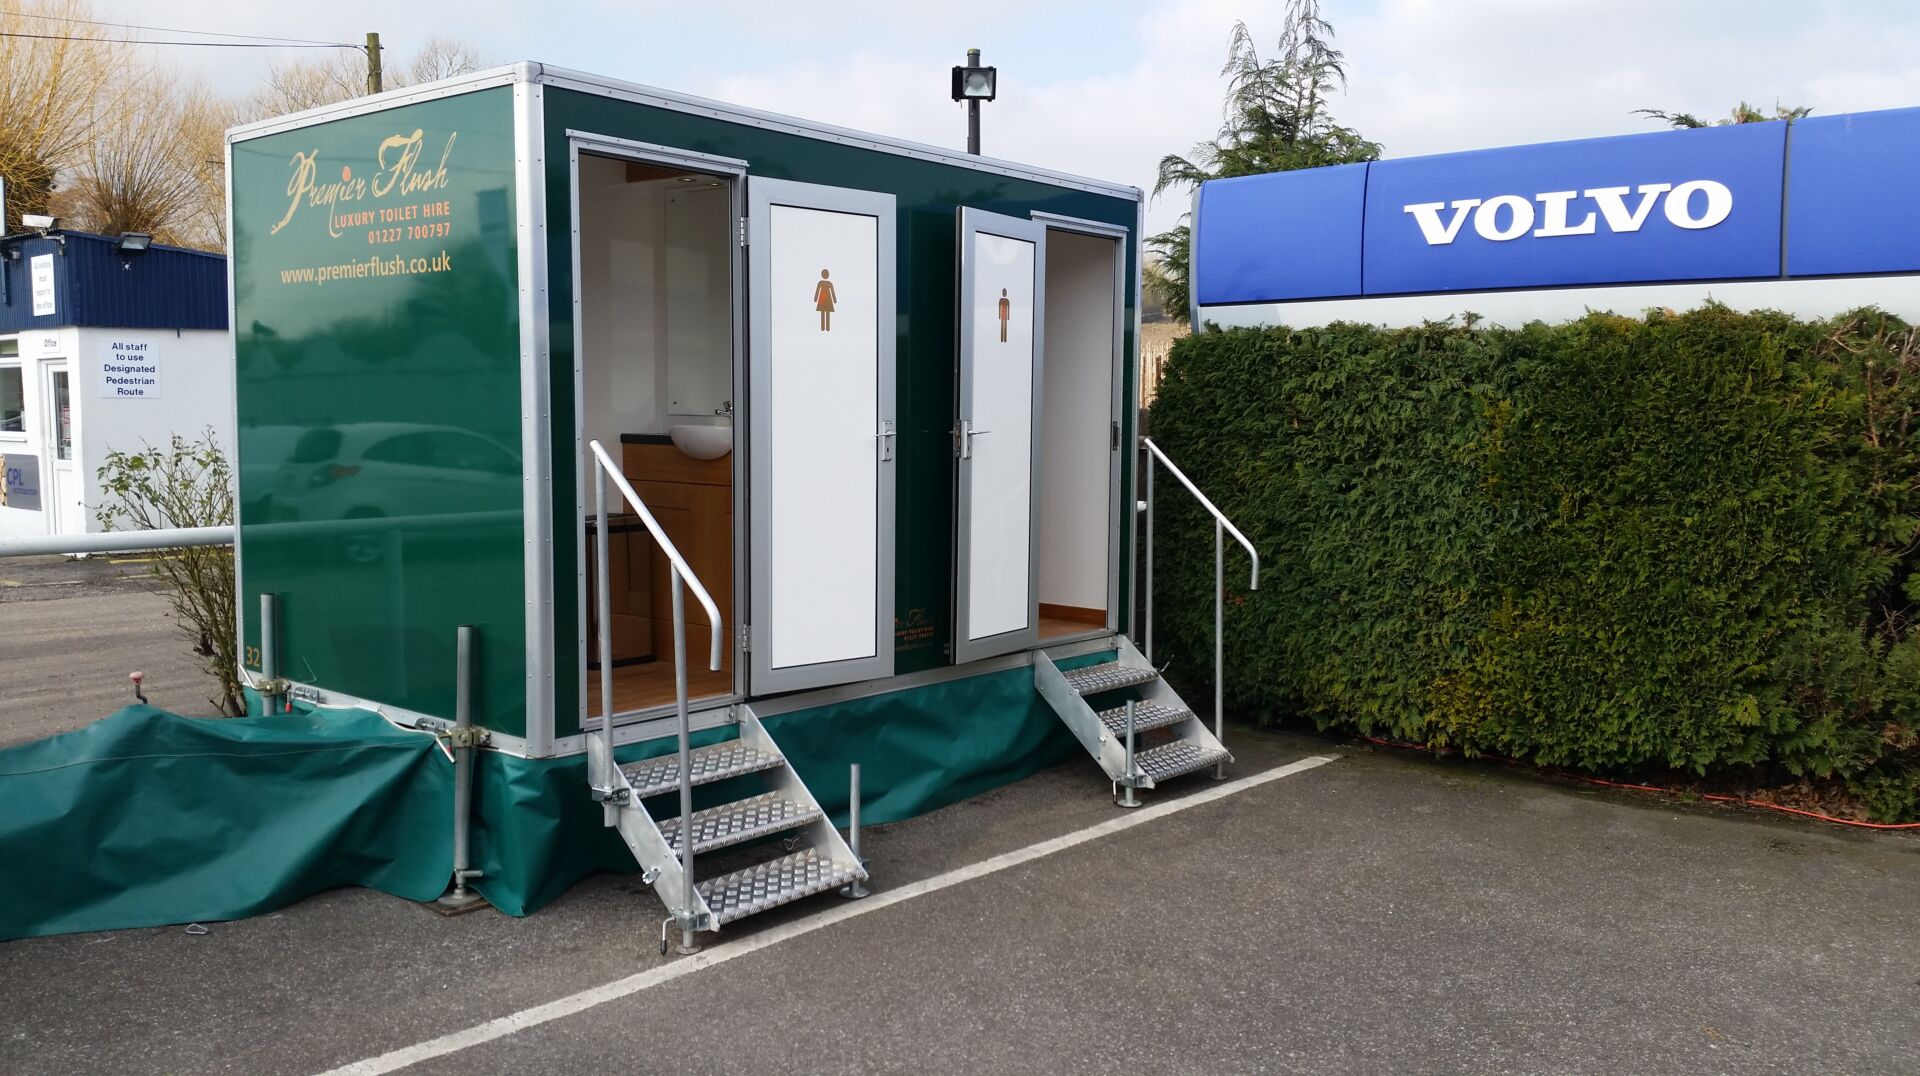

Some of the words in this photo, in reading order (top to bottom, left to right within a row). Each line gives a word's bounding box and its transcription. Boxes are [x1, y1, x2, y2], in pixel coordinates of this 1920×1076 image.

[270, 148, 367, 238] Premier
[371, 128, 457, 198] Flush
[334, 211, 375, 229] LUXURY
[379, 205, 418, 222] TOILET
[423, 200, 450, 217] HIRE
[1403, 179, 1733, 246] VOLVO
[368, 227, 402, 244] 01227
[407, 222, 451, 240] 700797
[281, 250, 451, 285] www.premierflush.co.uk
[112, 342, 124, 350] All
[125, 343, 148, 351] staff
[116, 353, 126, 361] to
[104, 364, 156, 374] Designated
[106, 376, 155, 385] Pedestrian
[117, 387, 144, 396] Route
[7, 467, 24, 486] CPL
[246, 646, 260, 668] 32
